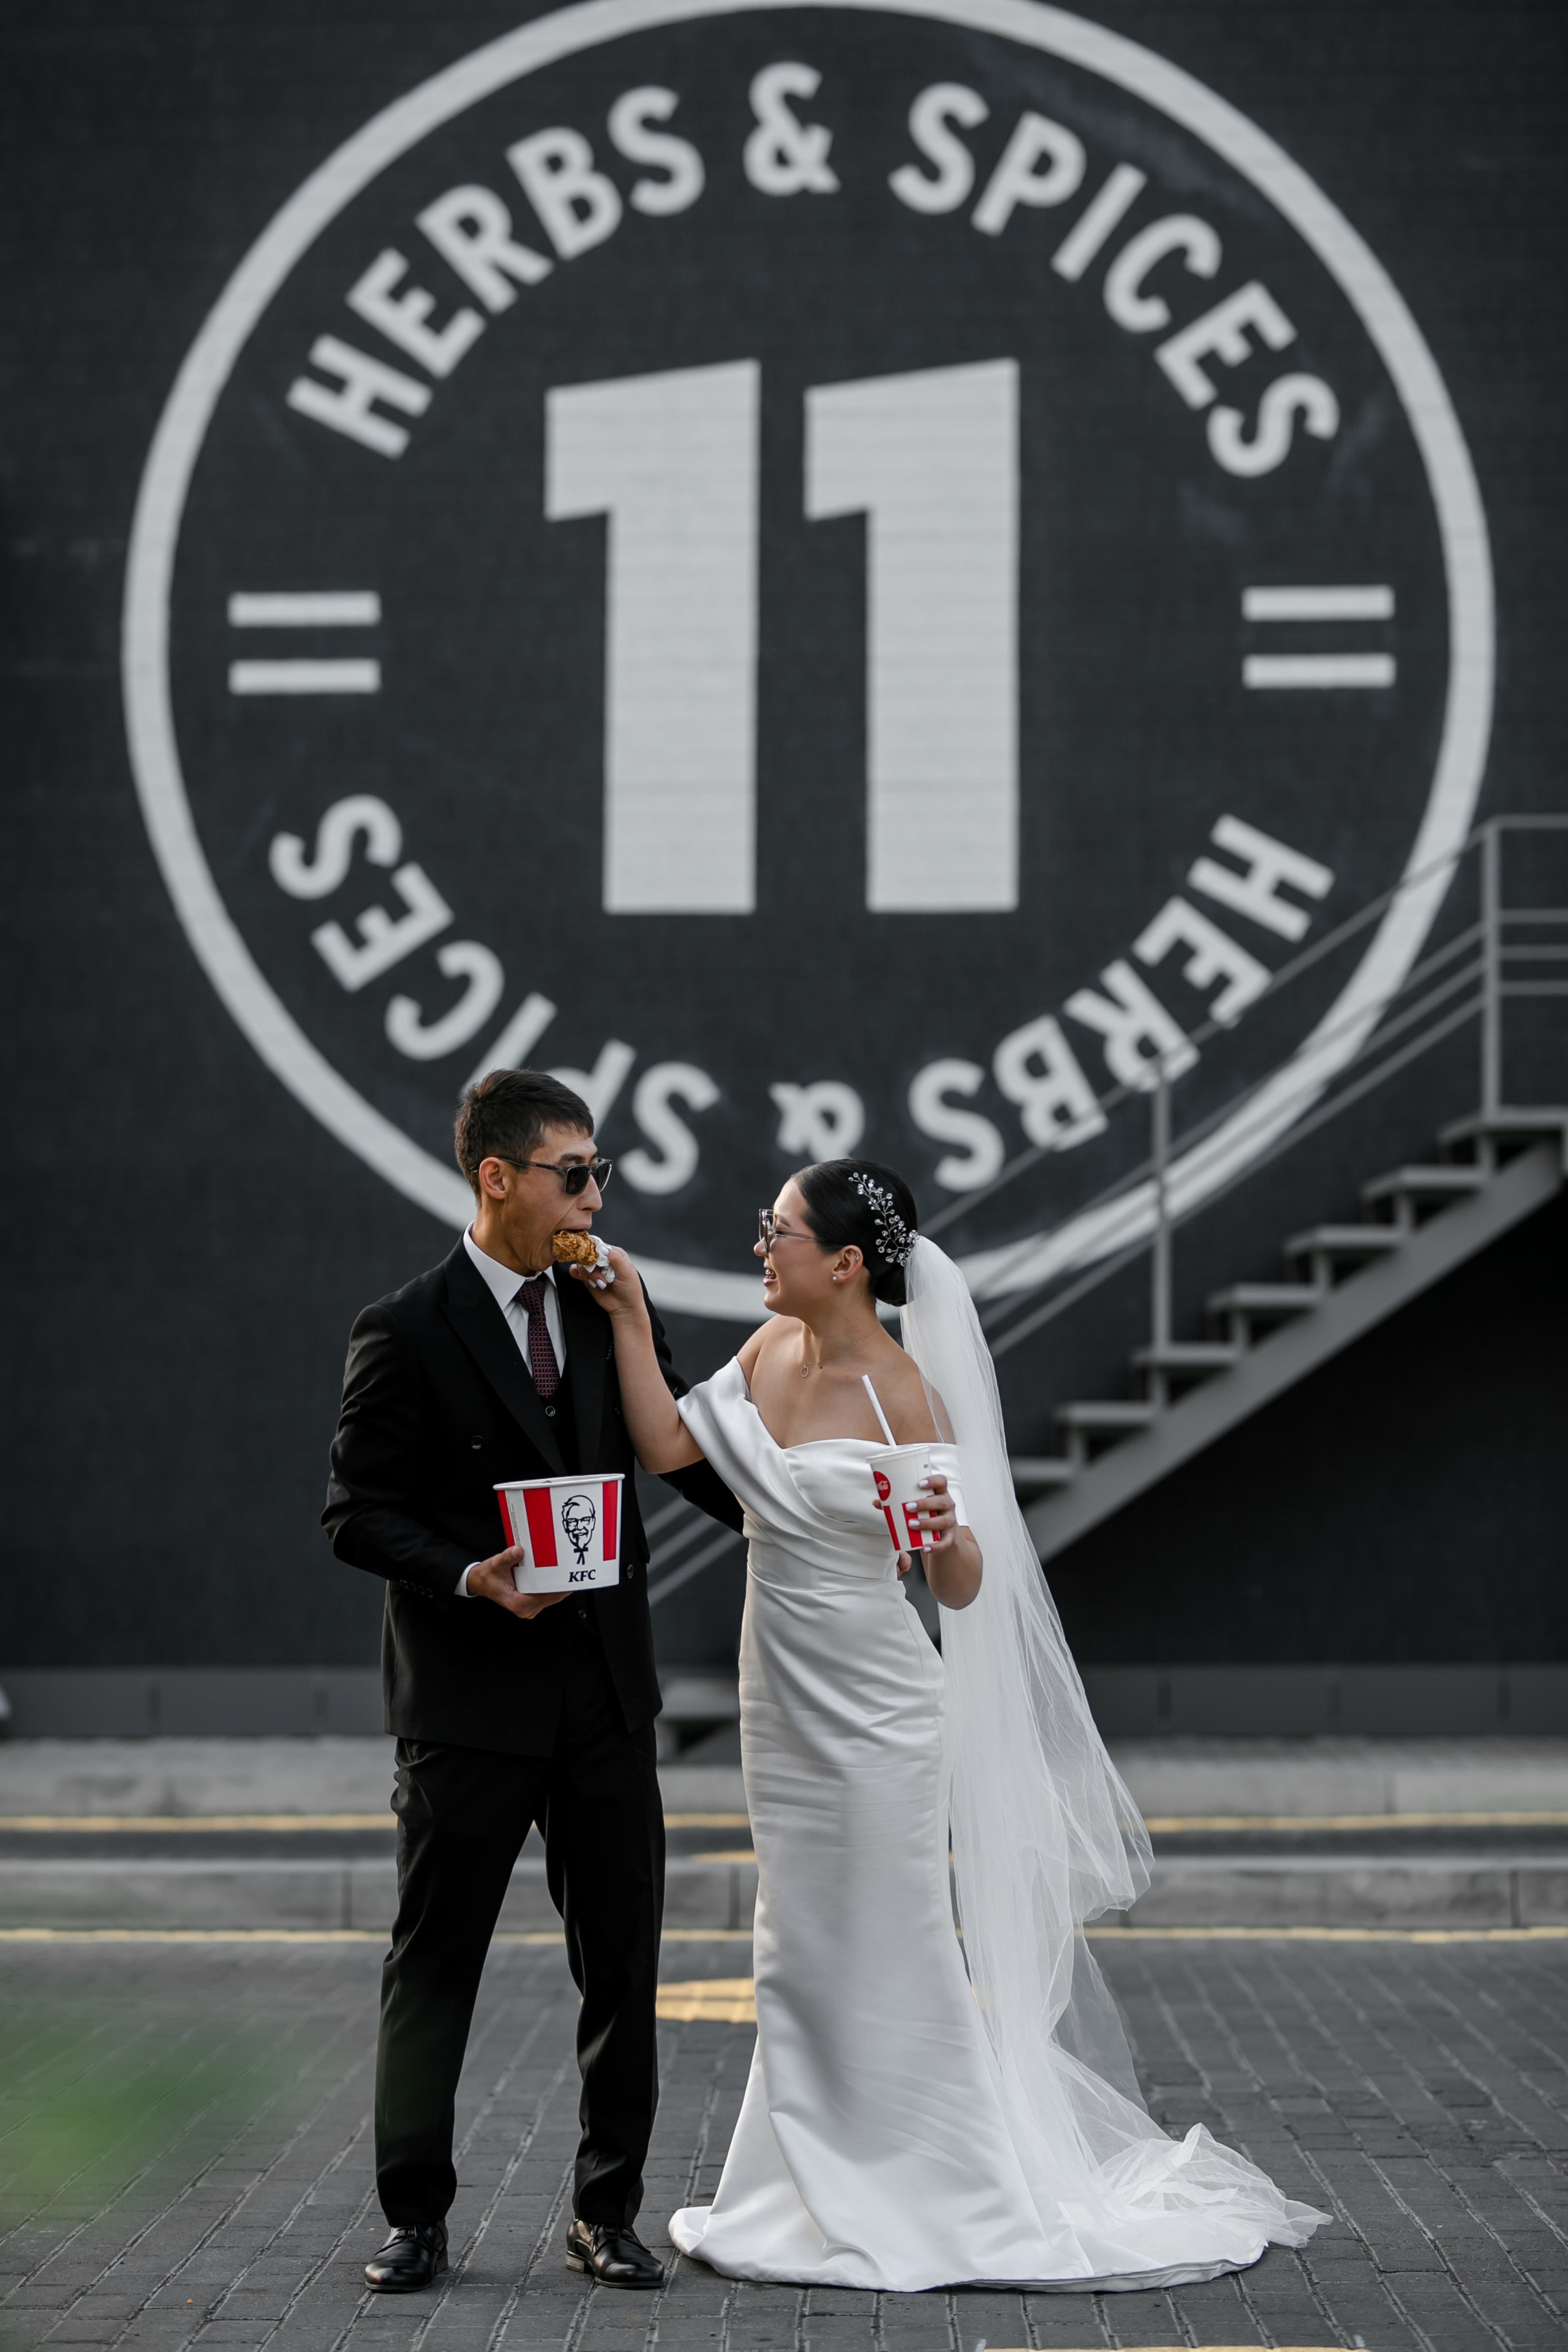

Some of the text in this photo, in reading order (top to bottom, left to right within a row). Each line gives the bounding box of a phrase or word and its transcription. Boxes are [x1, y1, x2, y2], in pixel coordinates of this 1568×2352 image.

[286, 62, 1340, 477] HERBS & SPICES
[545, 358, 1020, 914] 11
[769, 1080, 864, 1160] &
[909, 815, 1333, 1191] HERBS
[568, 1569, 596, 1583] KFC
